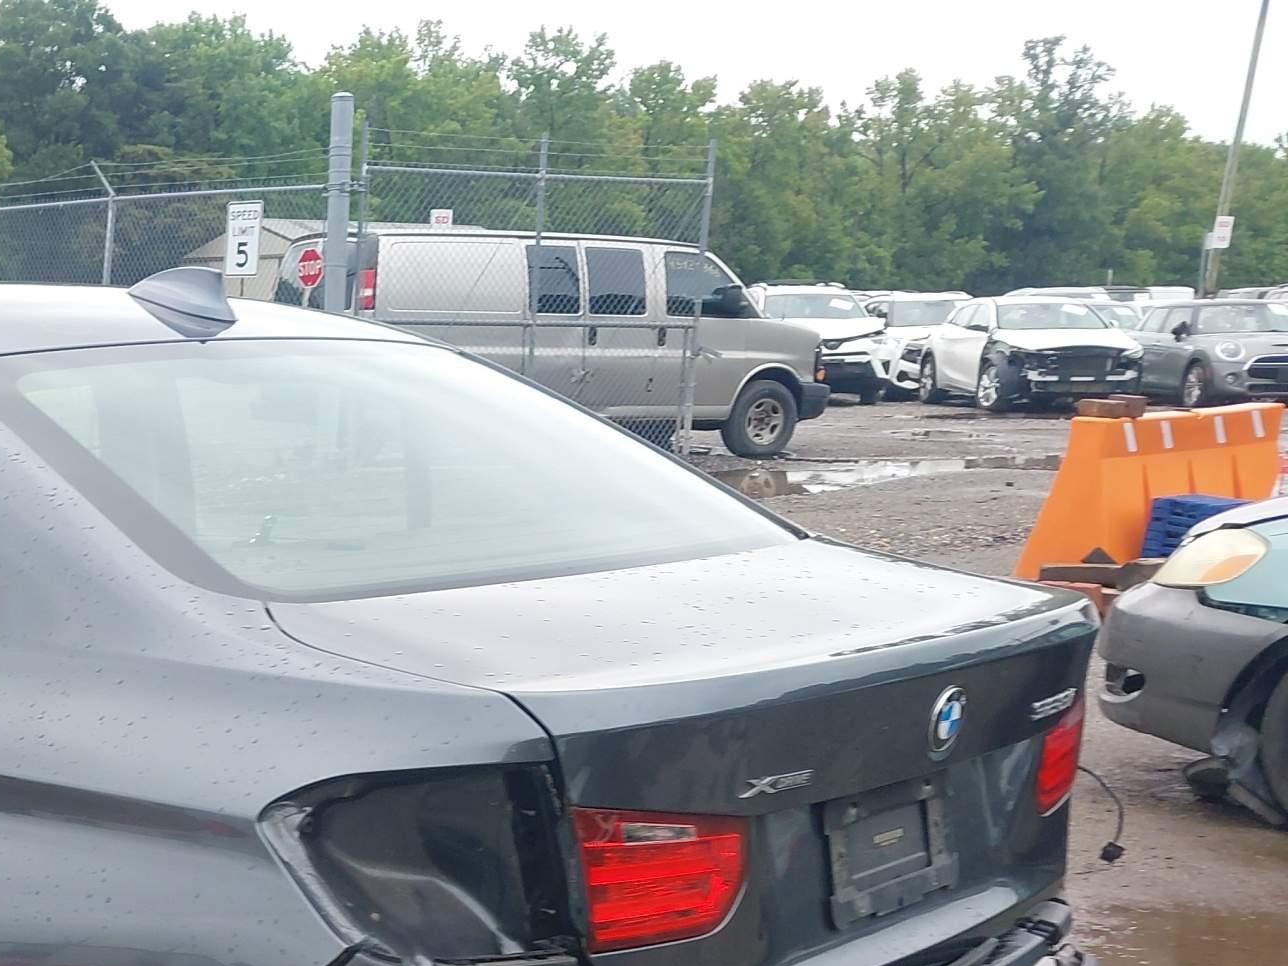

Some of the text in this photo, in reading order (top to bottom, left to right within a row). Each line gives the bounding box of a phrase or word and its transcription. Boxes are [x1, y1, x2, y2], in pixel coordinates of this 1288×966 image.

[230, 209, 259, 221] SPEED
[231, 225, 256, 237] LIMIT
[235, 241, 249, 268] 5
[298, 260, 323, 276] STOP
